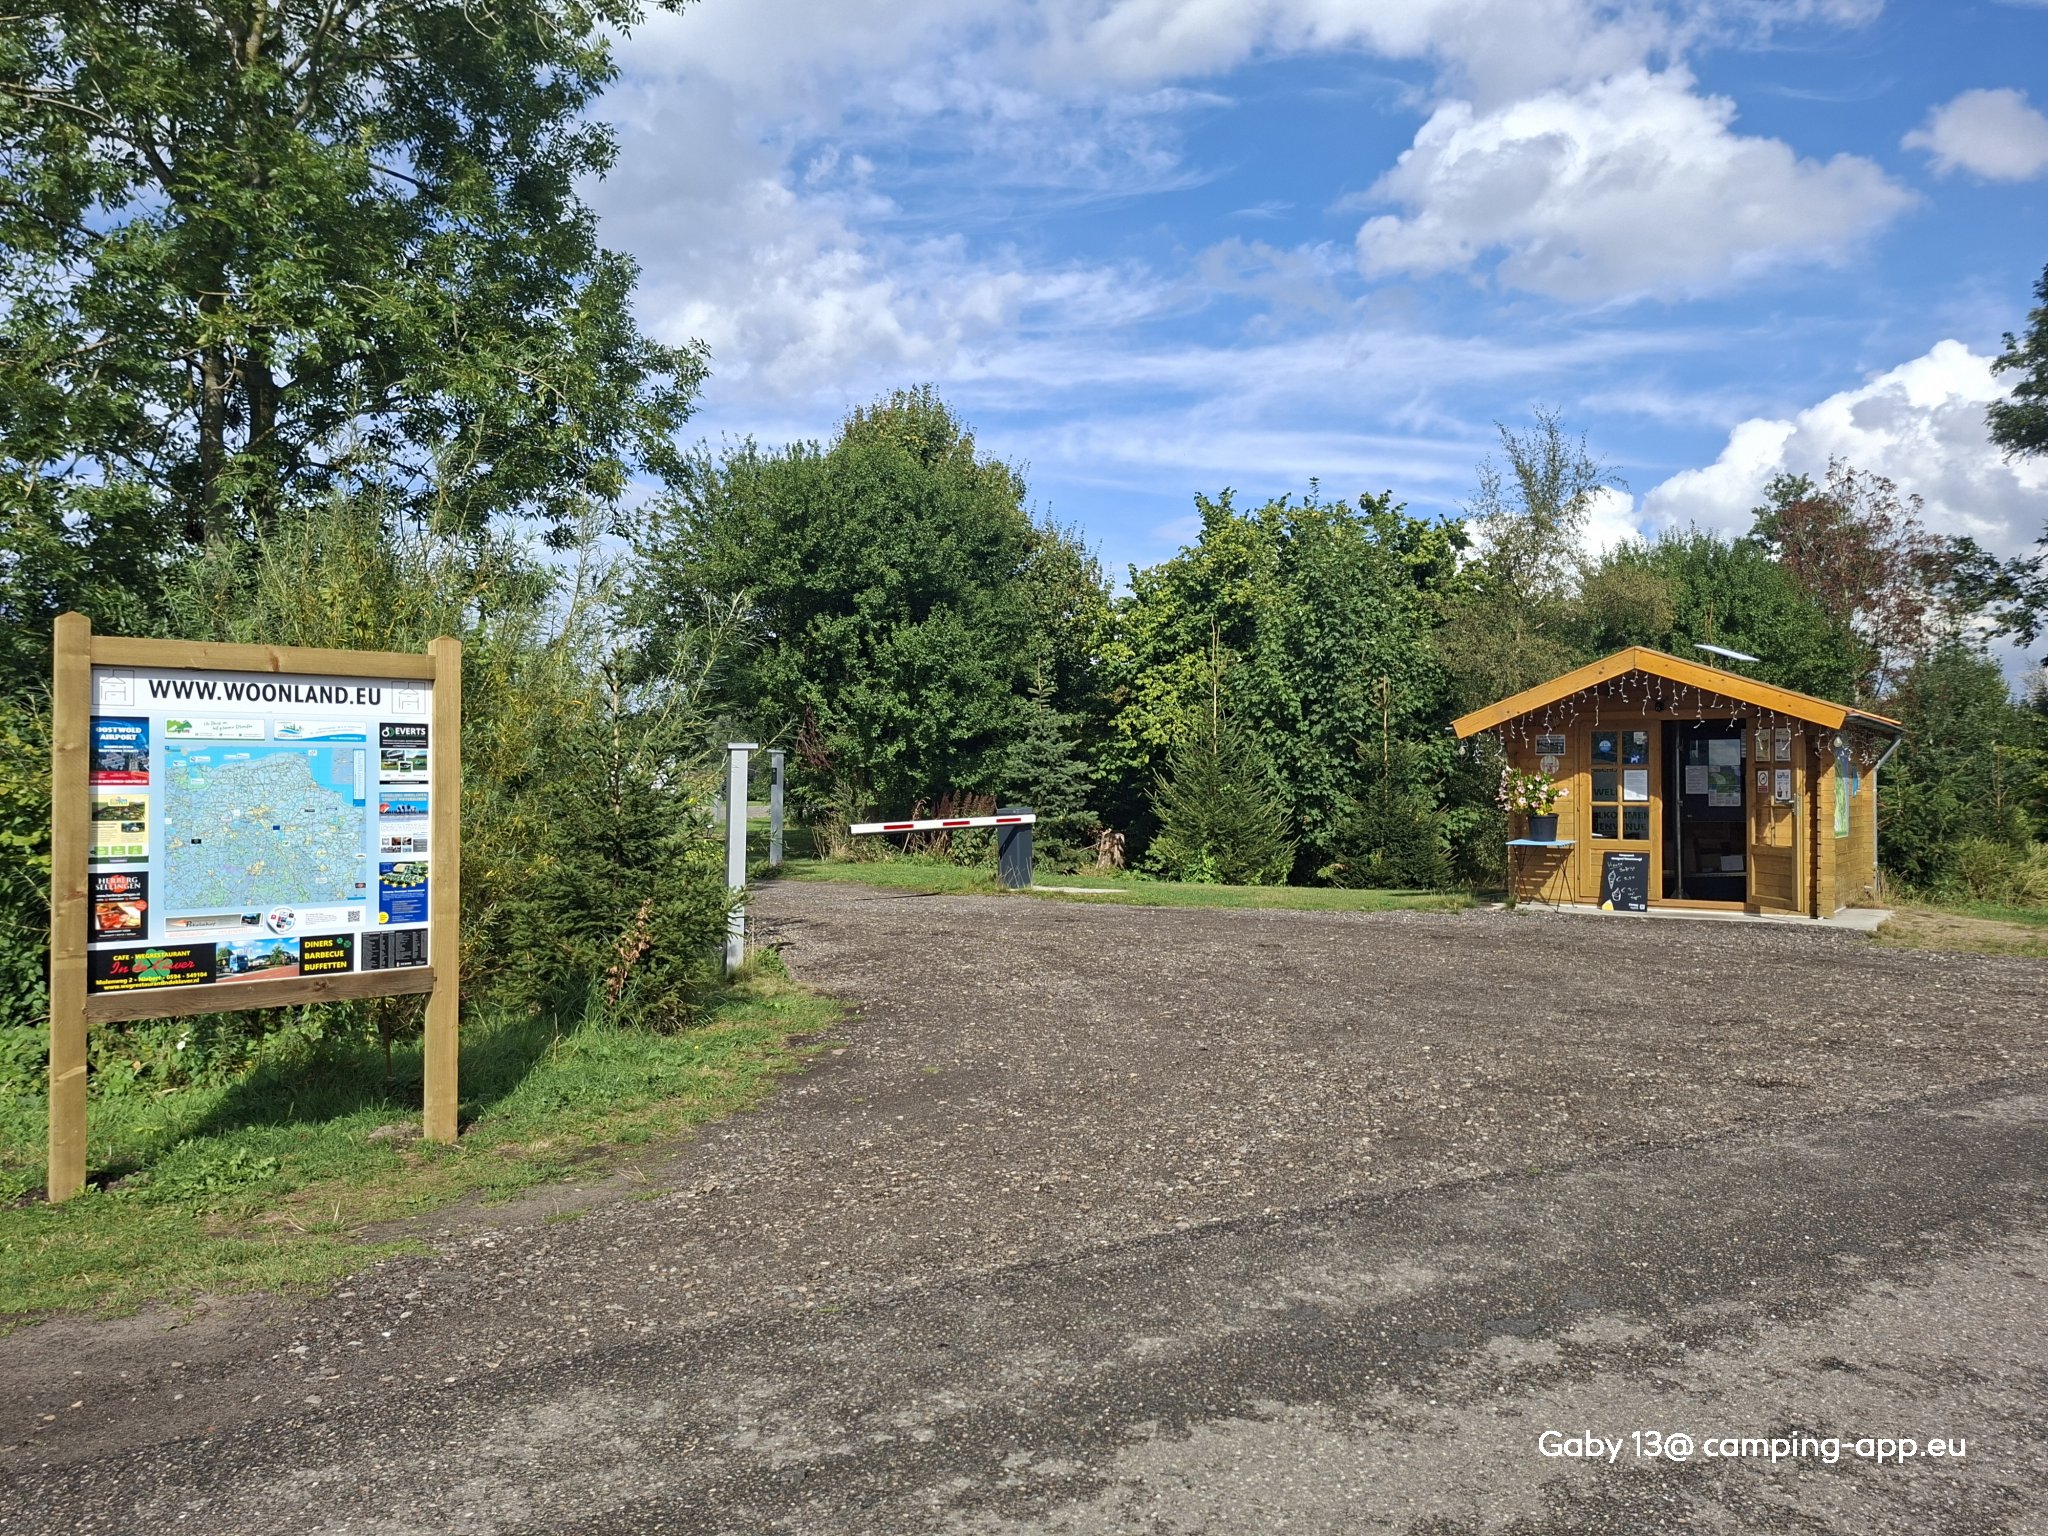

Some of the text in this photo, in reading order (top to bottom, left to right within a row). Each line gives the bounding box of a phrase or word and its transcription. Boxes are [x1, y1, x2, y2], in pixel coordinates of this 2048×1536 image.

[148, 680, 381, 706] WWW.WOONLAND.EU
[395, 727, 426, 735] EVERTS
[98, 876, 138, 884] HERBERG
[304, 940, 333, 948] DINERS
[135, 950, 191, 960] WEGRESTAURANT
[304, 950, 344, 959] BARBECUE
[304, 961, 347, 971] BUFFETTEN
